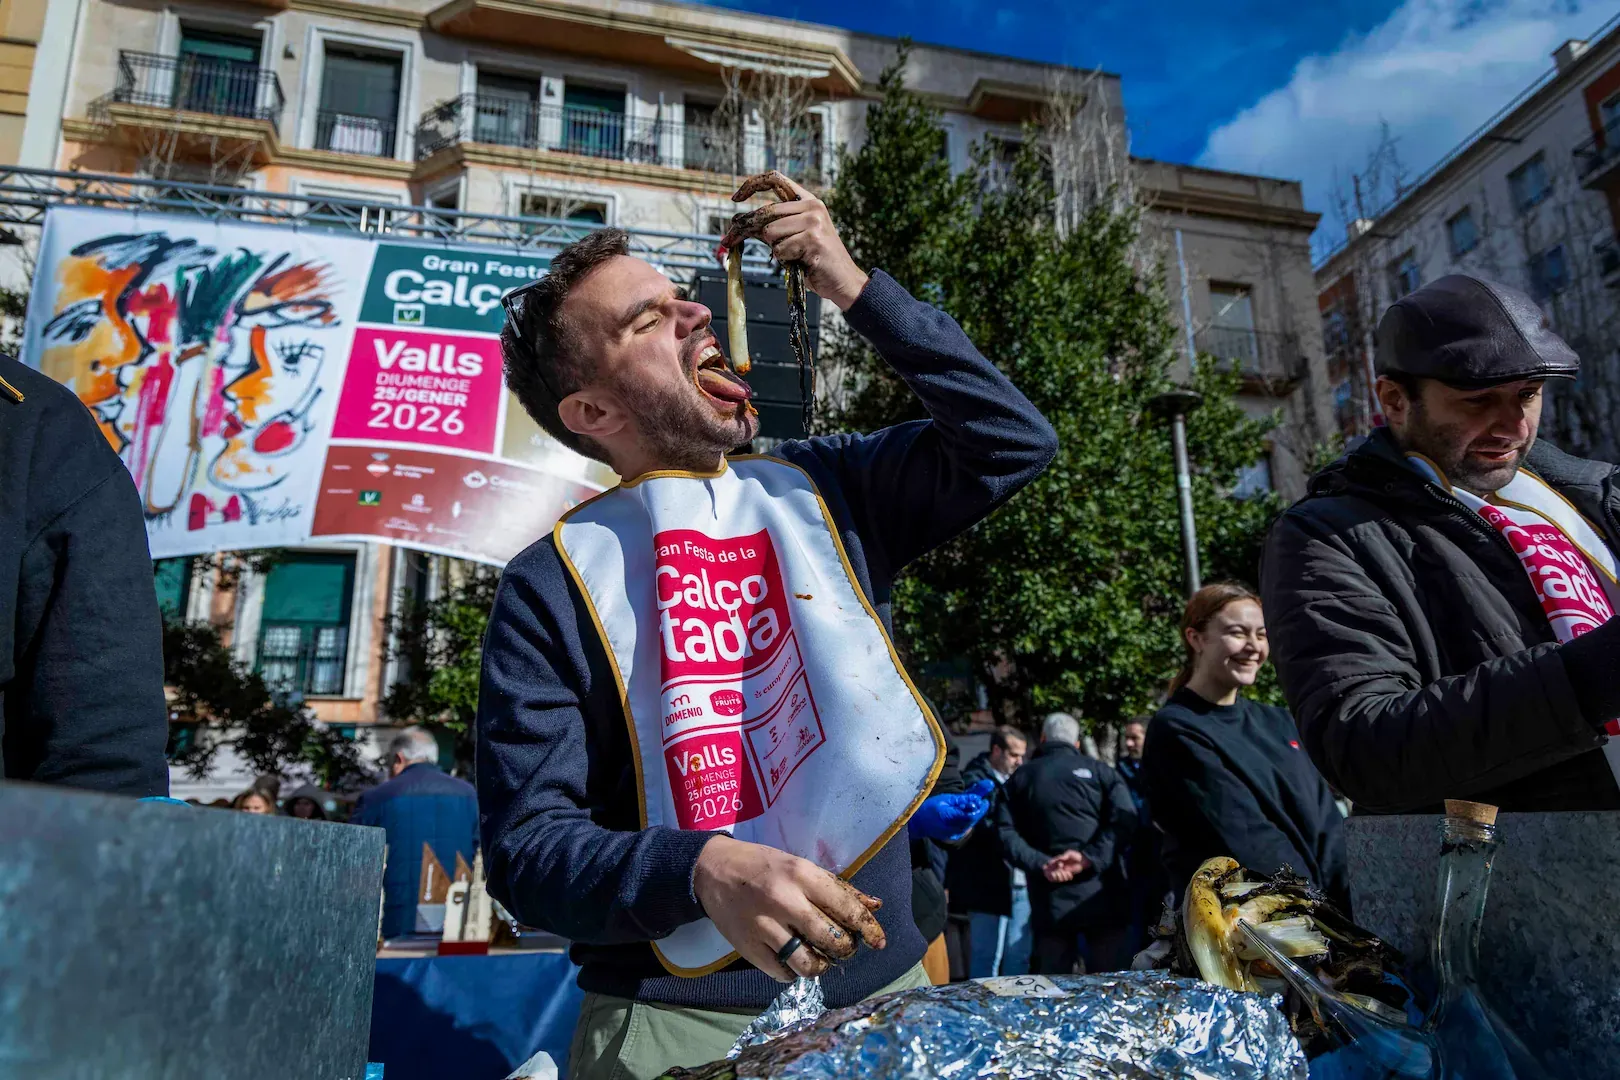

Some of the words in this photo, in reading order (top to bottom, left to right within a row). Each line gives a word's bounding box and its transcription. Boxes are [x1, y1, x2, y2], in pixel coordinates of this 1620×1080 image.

[422, 254, 479, 274] Gran
[373, 338, 483, 377] Valls
[376, 371, 472, 393] DIUMENGE
[373, 386, 468, 407] 25/GENER
[367, 401, 465, 435] 2026
[655, 544, 680, 559] ran
[684, 541, 716, 562] Festa
[718, 550, 738, 563] de
[740, 547, 757, 560] la
[659, 608, 780, 662] tada
[715, 698, 741, 706] FRUITS
[665, 706, 703, 727] DOMENIO
[673, 744, 737, 777] Valls
[688, 779, 738, 801] 25/GENER
[691, 792, 743, 823] 2026
